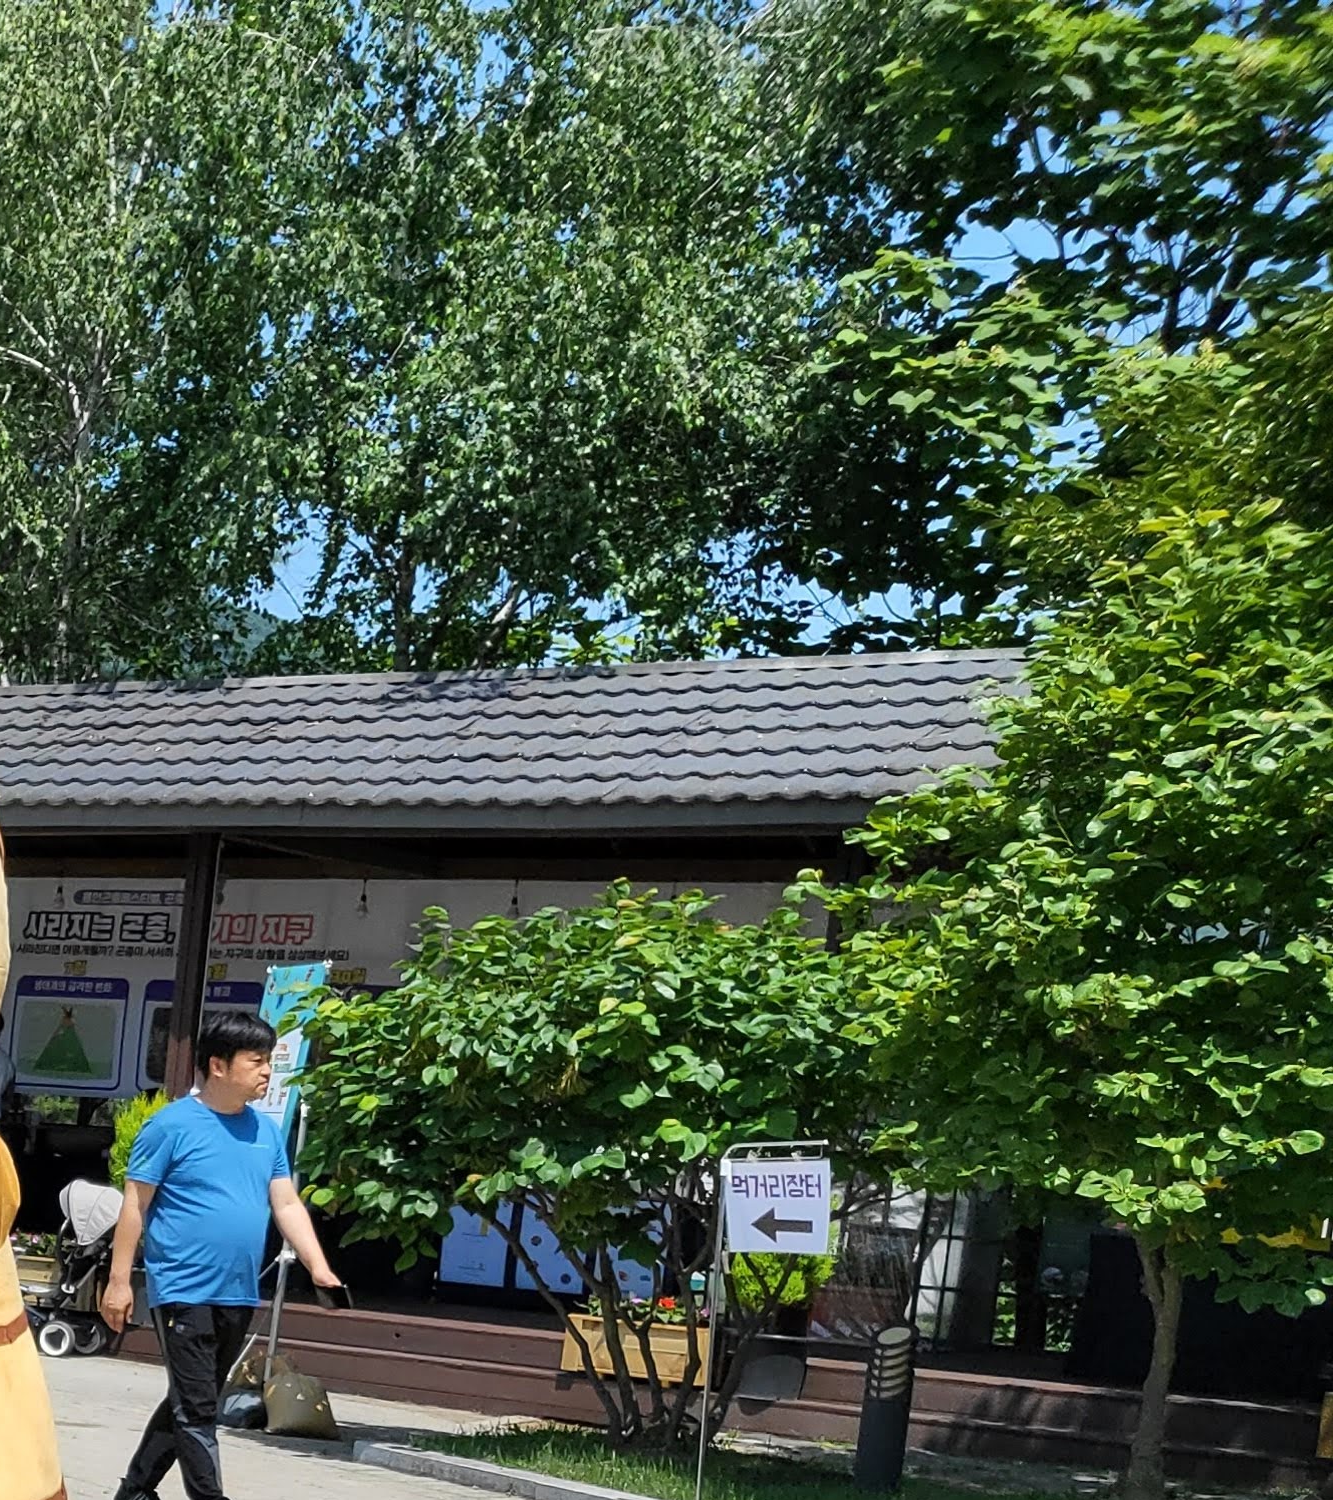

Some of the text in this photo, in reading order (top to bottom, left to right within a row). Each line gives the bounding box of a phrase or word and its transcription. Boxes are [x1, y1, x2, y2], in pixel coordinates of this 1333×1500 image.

[23, 911, 115, 942] 사라지는
[120, 912, 176, 943] 곤충,
[261, 914, 314, 945] 지구
[732, 1173, 822, 1199] 먹거리장터
